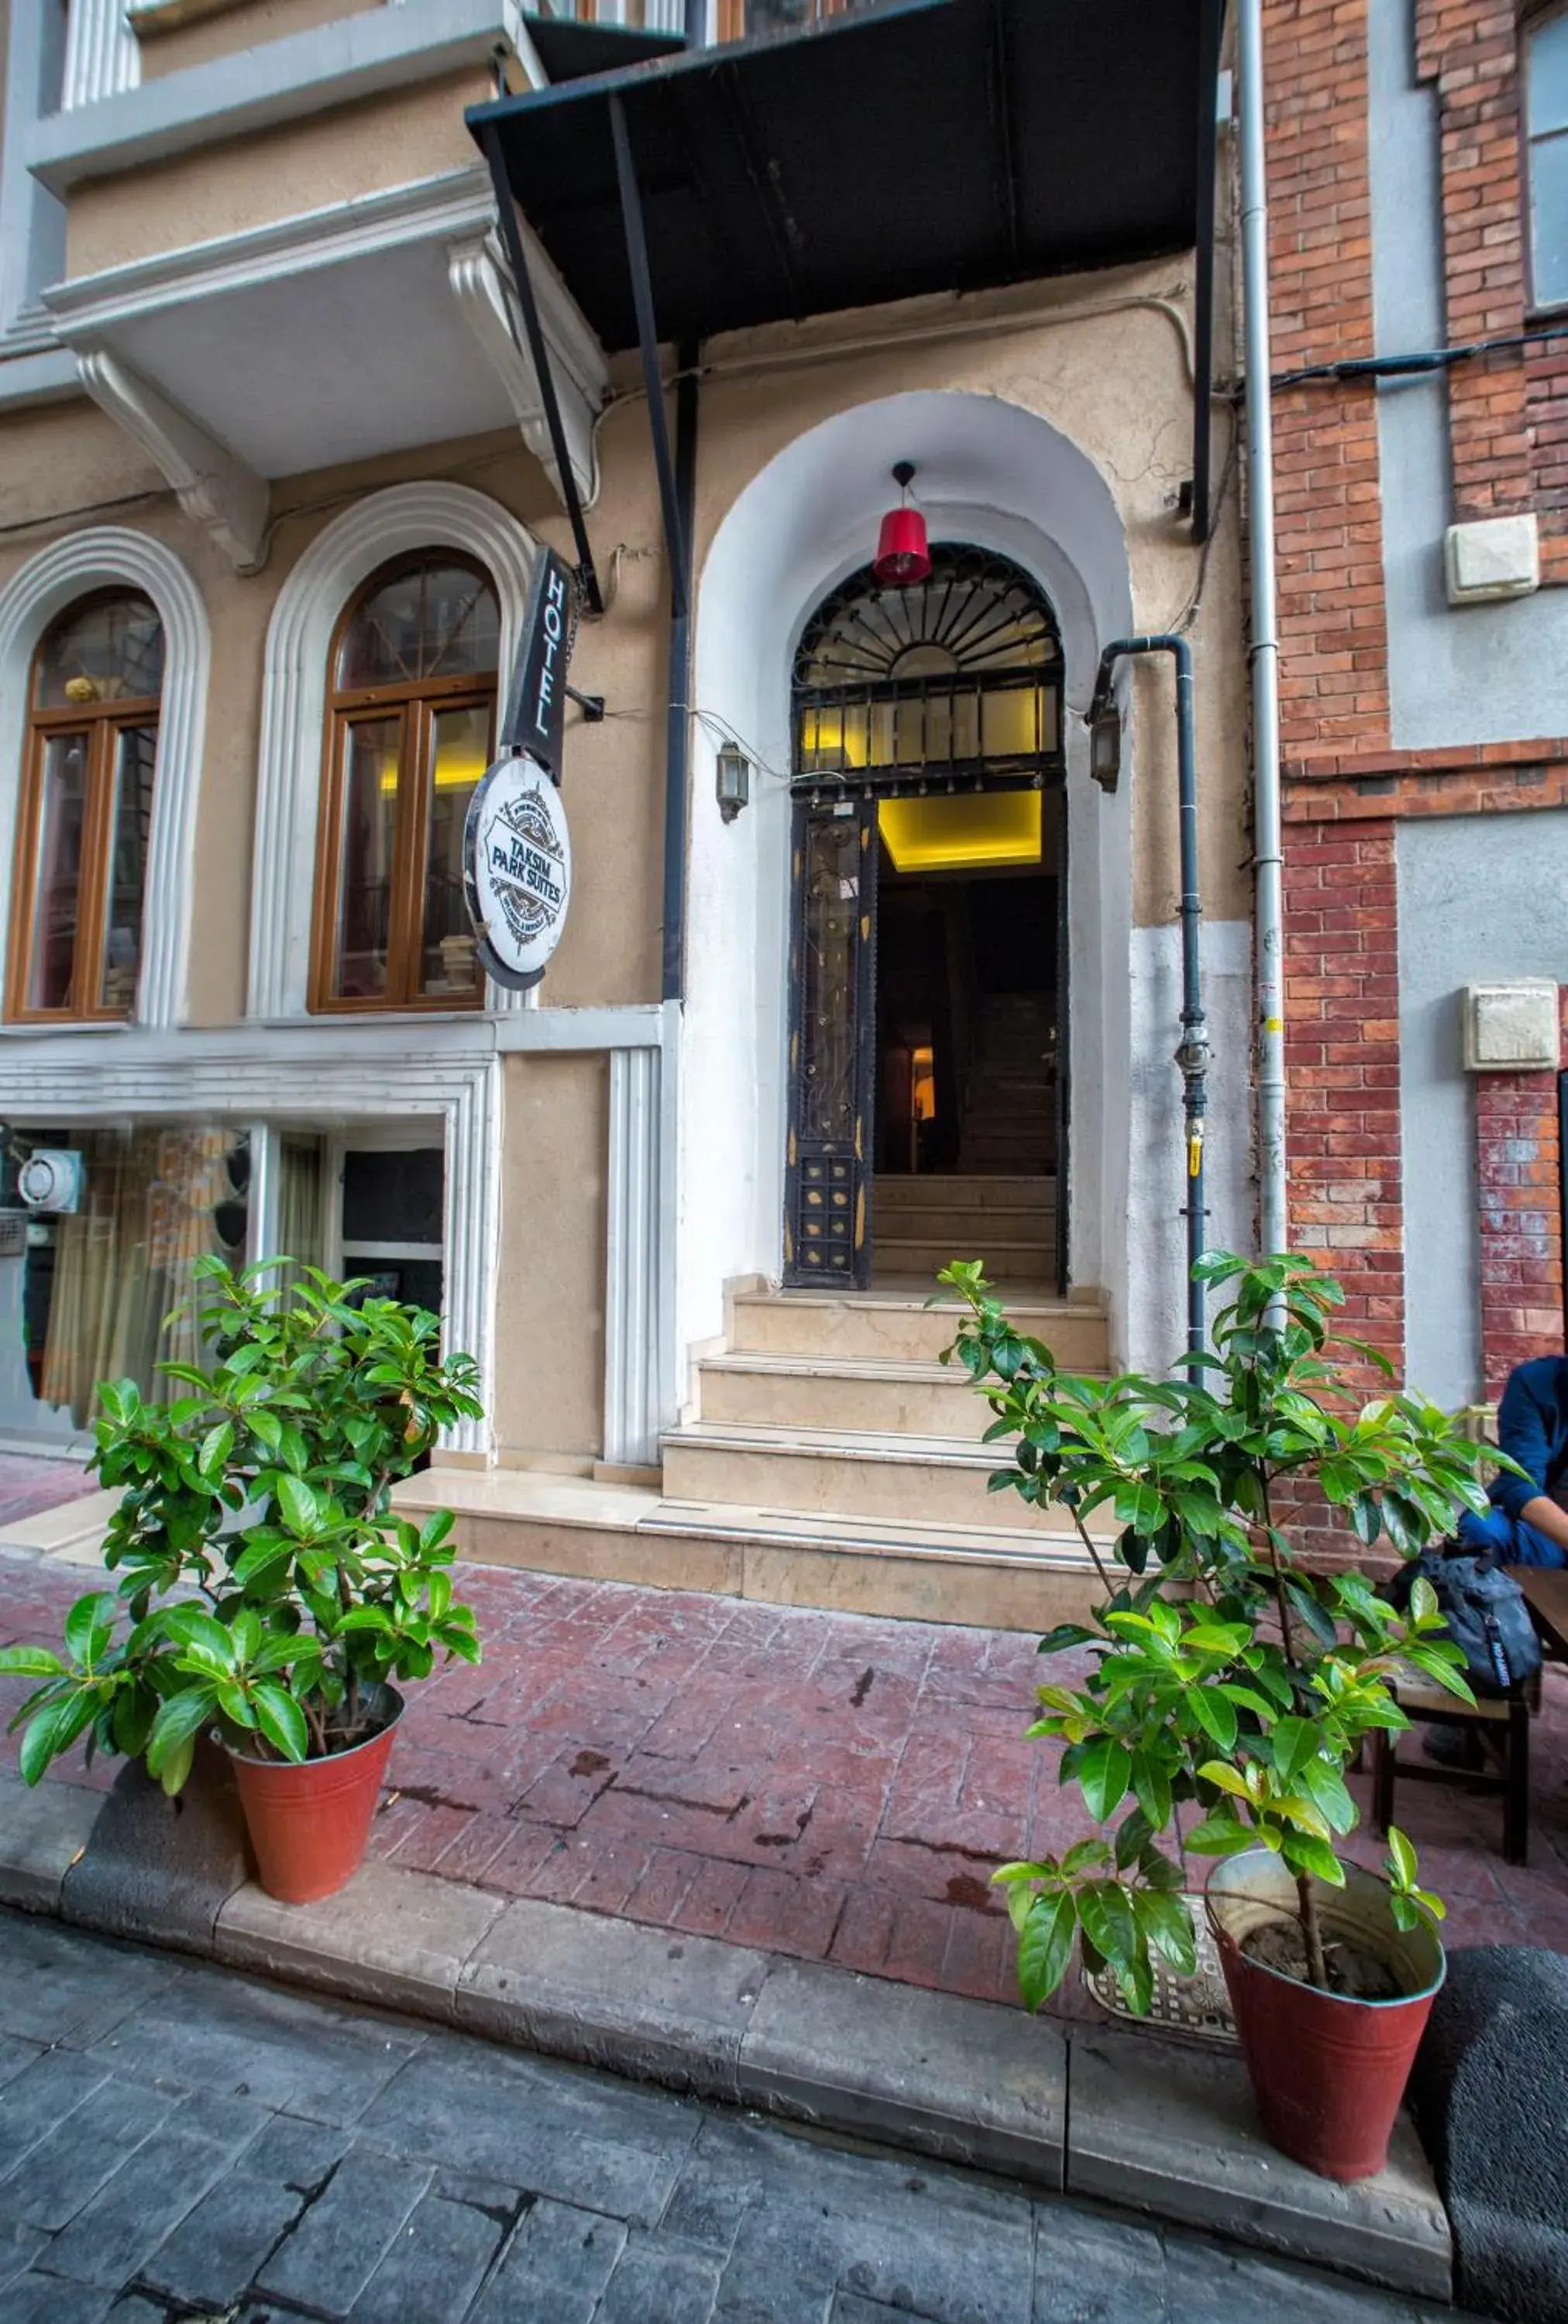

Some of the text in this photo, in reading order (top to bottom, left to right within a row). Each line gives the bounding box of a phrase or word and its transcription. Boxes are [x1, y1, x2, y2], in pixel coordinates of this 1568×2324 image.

[536, 569, 564, 737] HOTEL
[492, 846, 560, 904] PARK SUITES
[511, 837, 551, 879] TAKSIM
